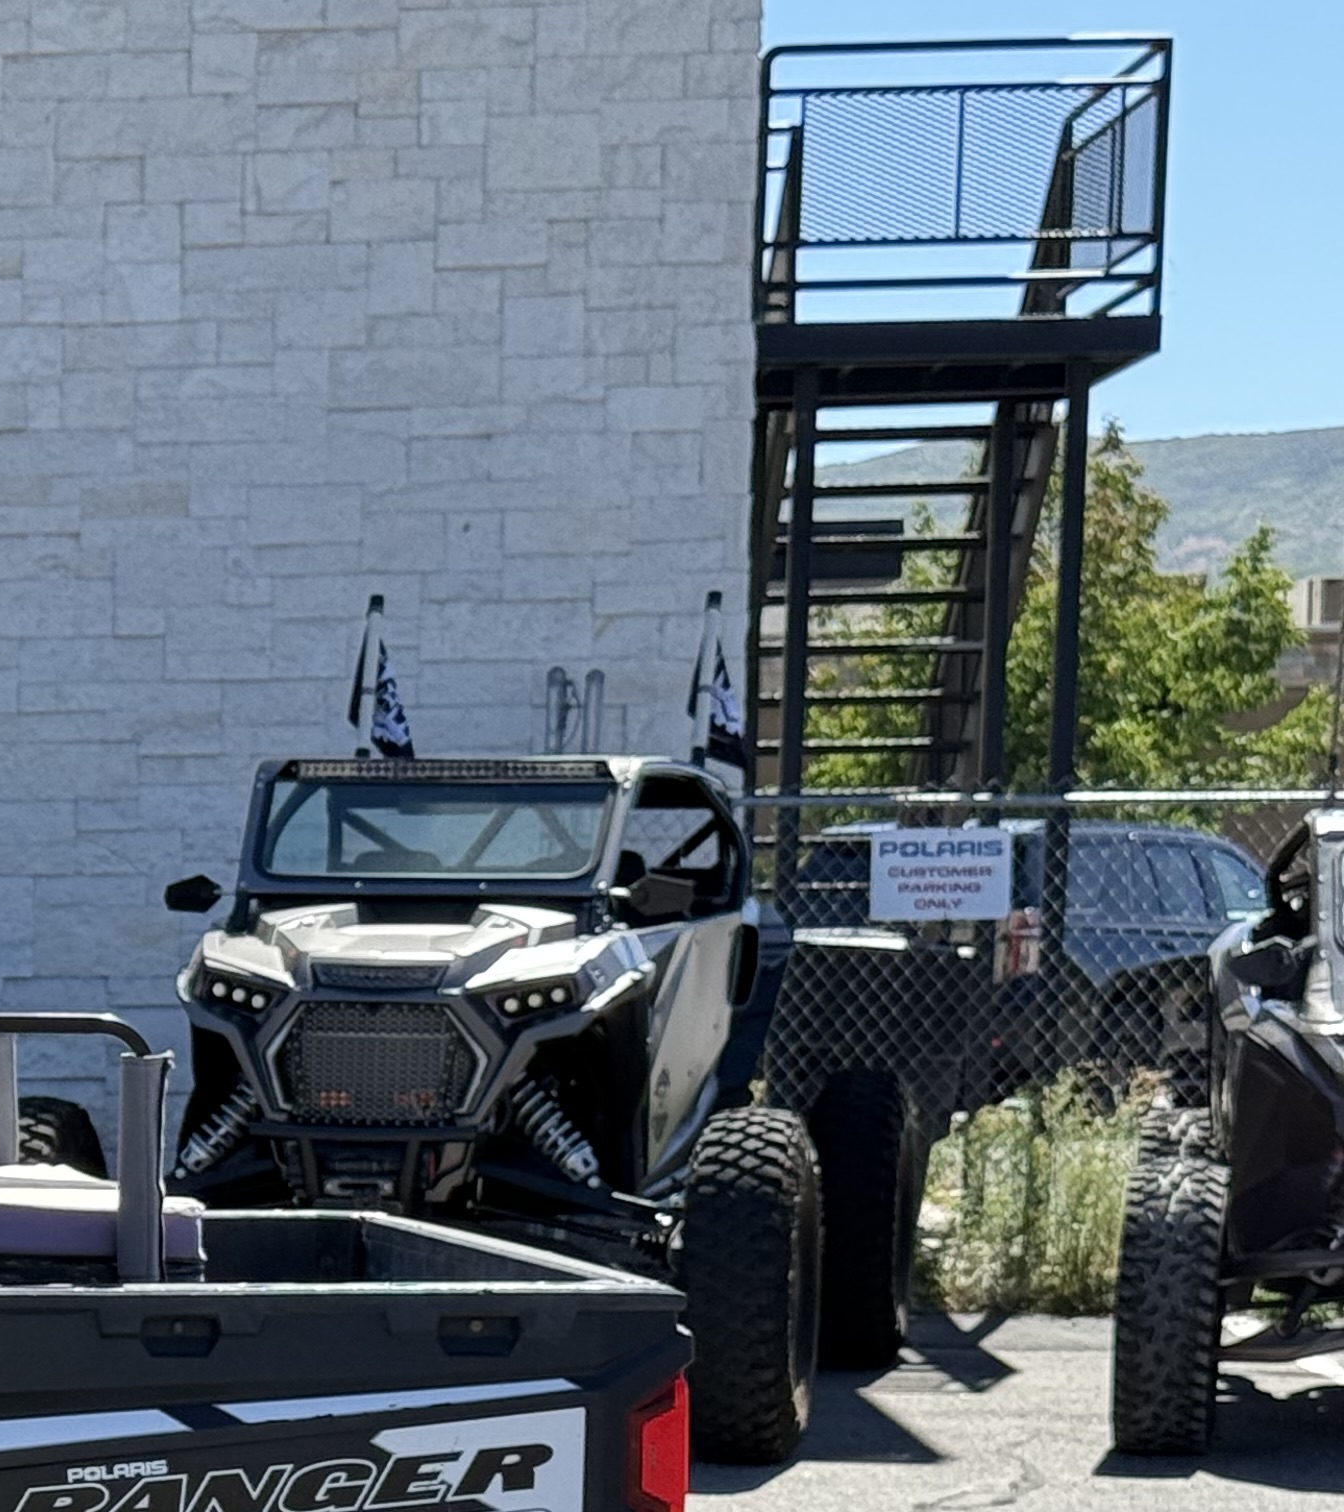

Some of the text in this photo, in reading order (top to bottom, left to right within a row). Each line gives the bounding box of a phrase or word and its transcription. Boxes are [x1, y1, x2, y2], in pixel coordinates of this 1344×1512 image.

[878, 839, 1003, 859] POLARIS
[887, 865, 993, 879] CUSTOMER
[897, 882, 982, 894] PARKING
[913, 898, 962, 910] ONLY
[67, 1459, 169, 1484] POLARIS
